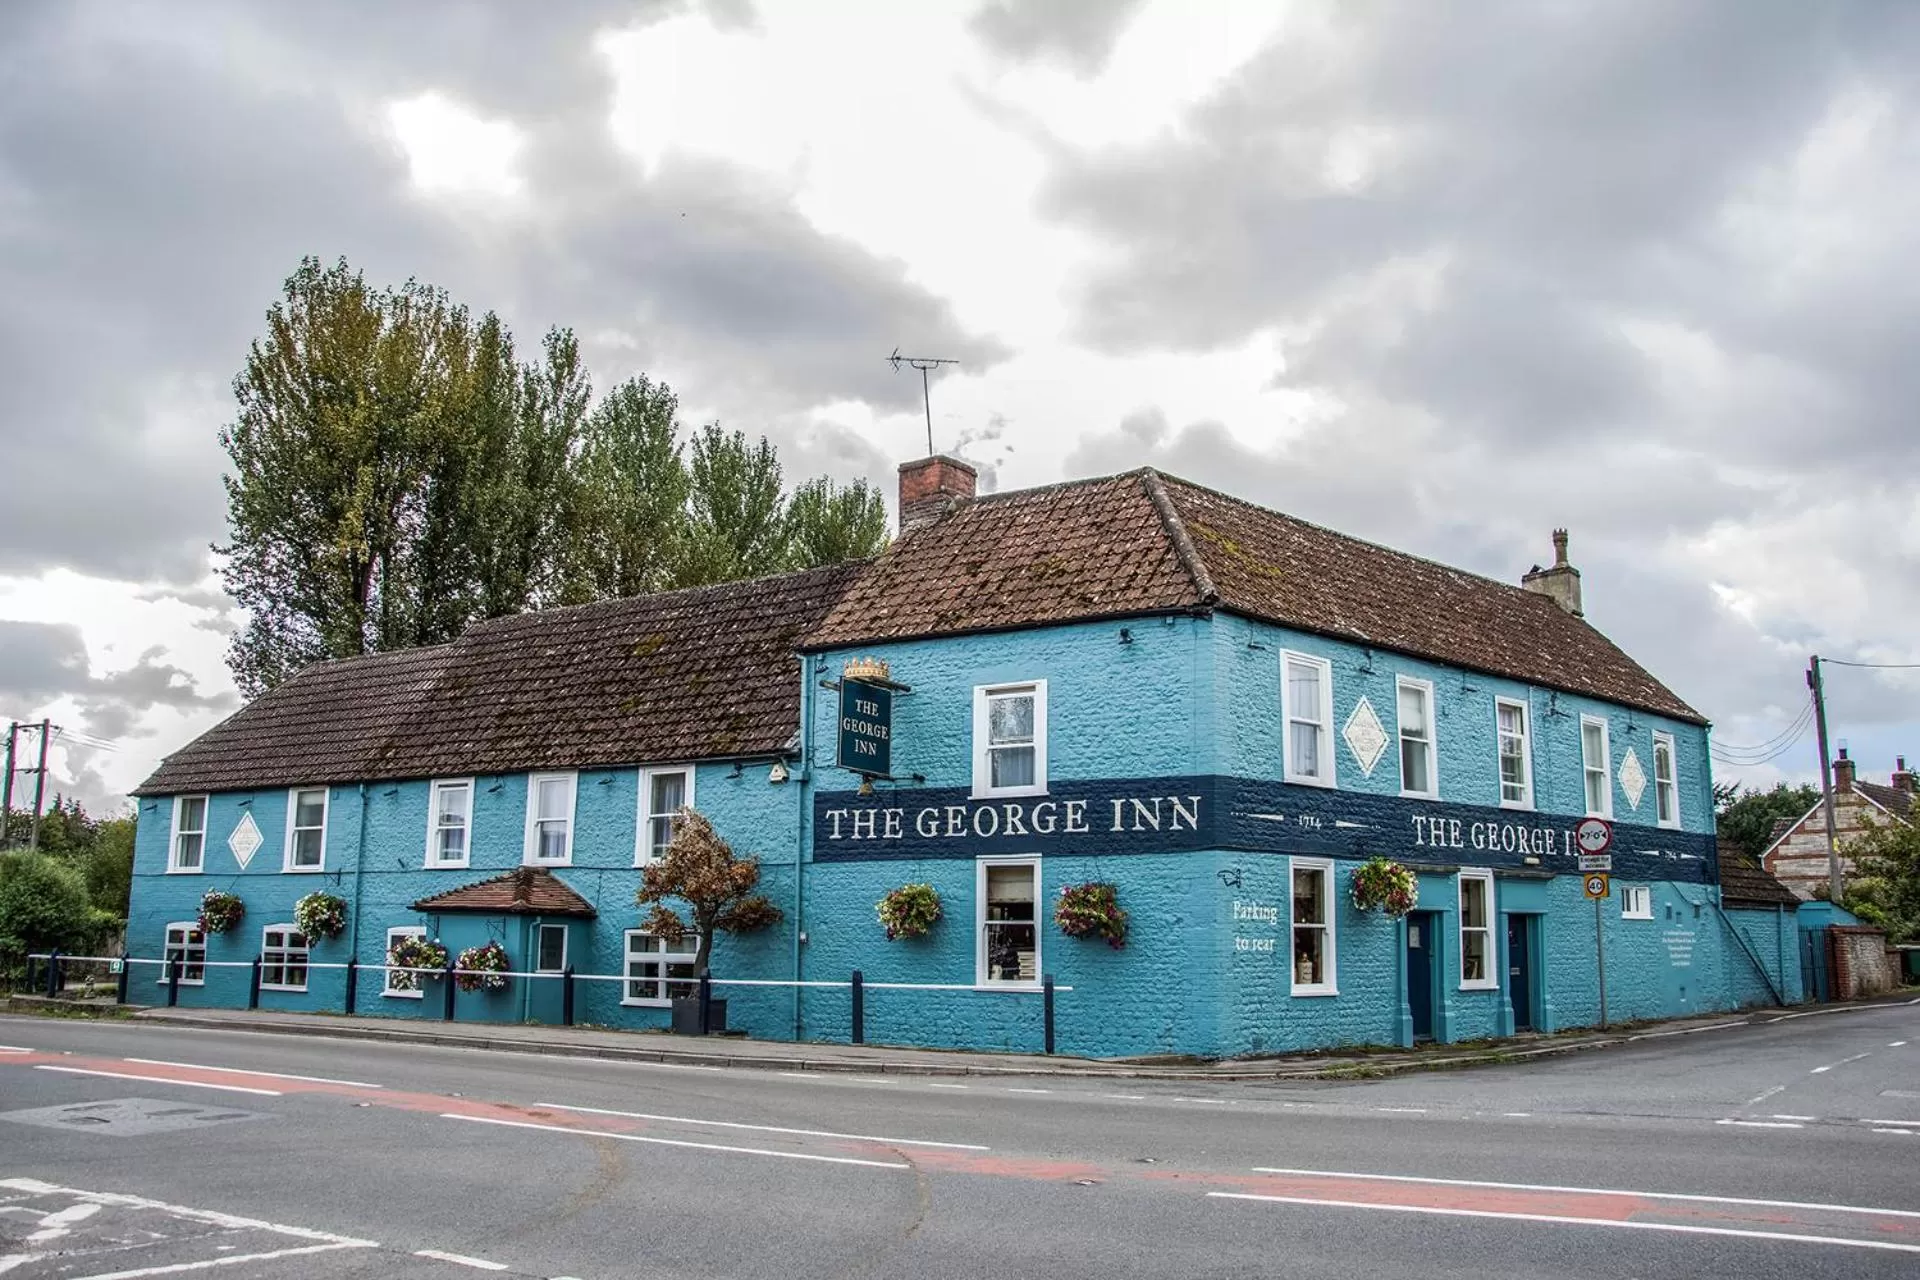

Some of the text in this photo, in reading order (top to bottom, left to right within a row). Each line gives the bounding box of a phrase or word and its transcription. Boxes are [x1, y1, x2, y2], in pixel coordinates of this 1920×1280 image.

[855, 699, 879, 717] THE
[843, 717, 889, 740] GEORGE
[854, 739, 877, 756] INN
[825, 796, 1201, 840] THE GEORGE INN
[1299, 815, 1322, 830] 1714
[1412, 814, 1464, 848] THE
[1471, 822, 1557, 856] GEORGE
[1590, 882, 1602, 890] 40
[1233, 900, 1278, 925] Parking
[1235, 936, 1276, 951] to rear
